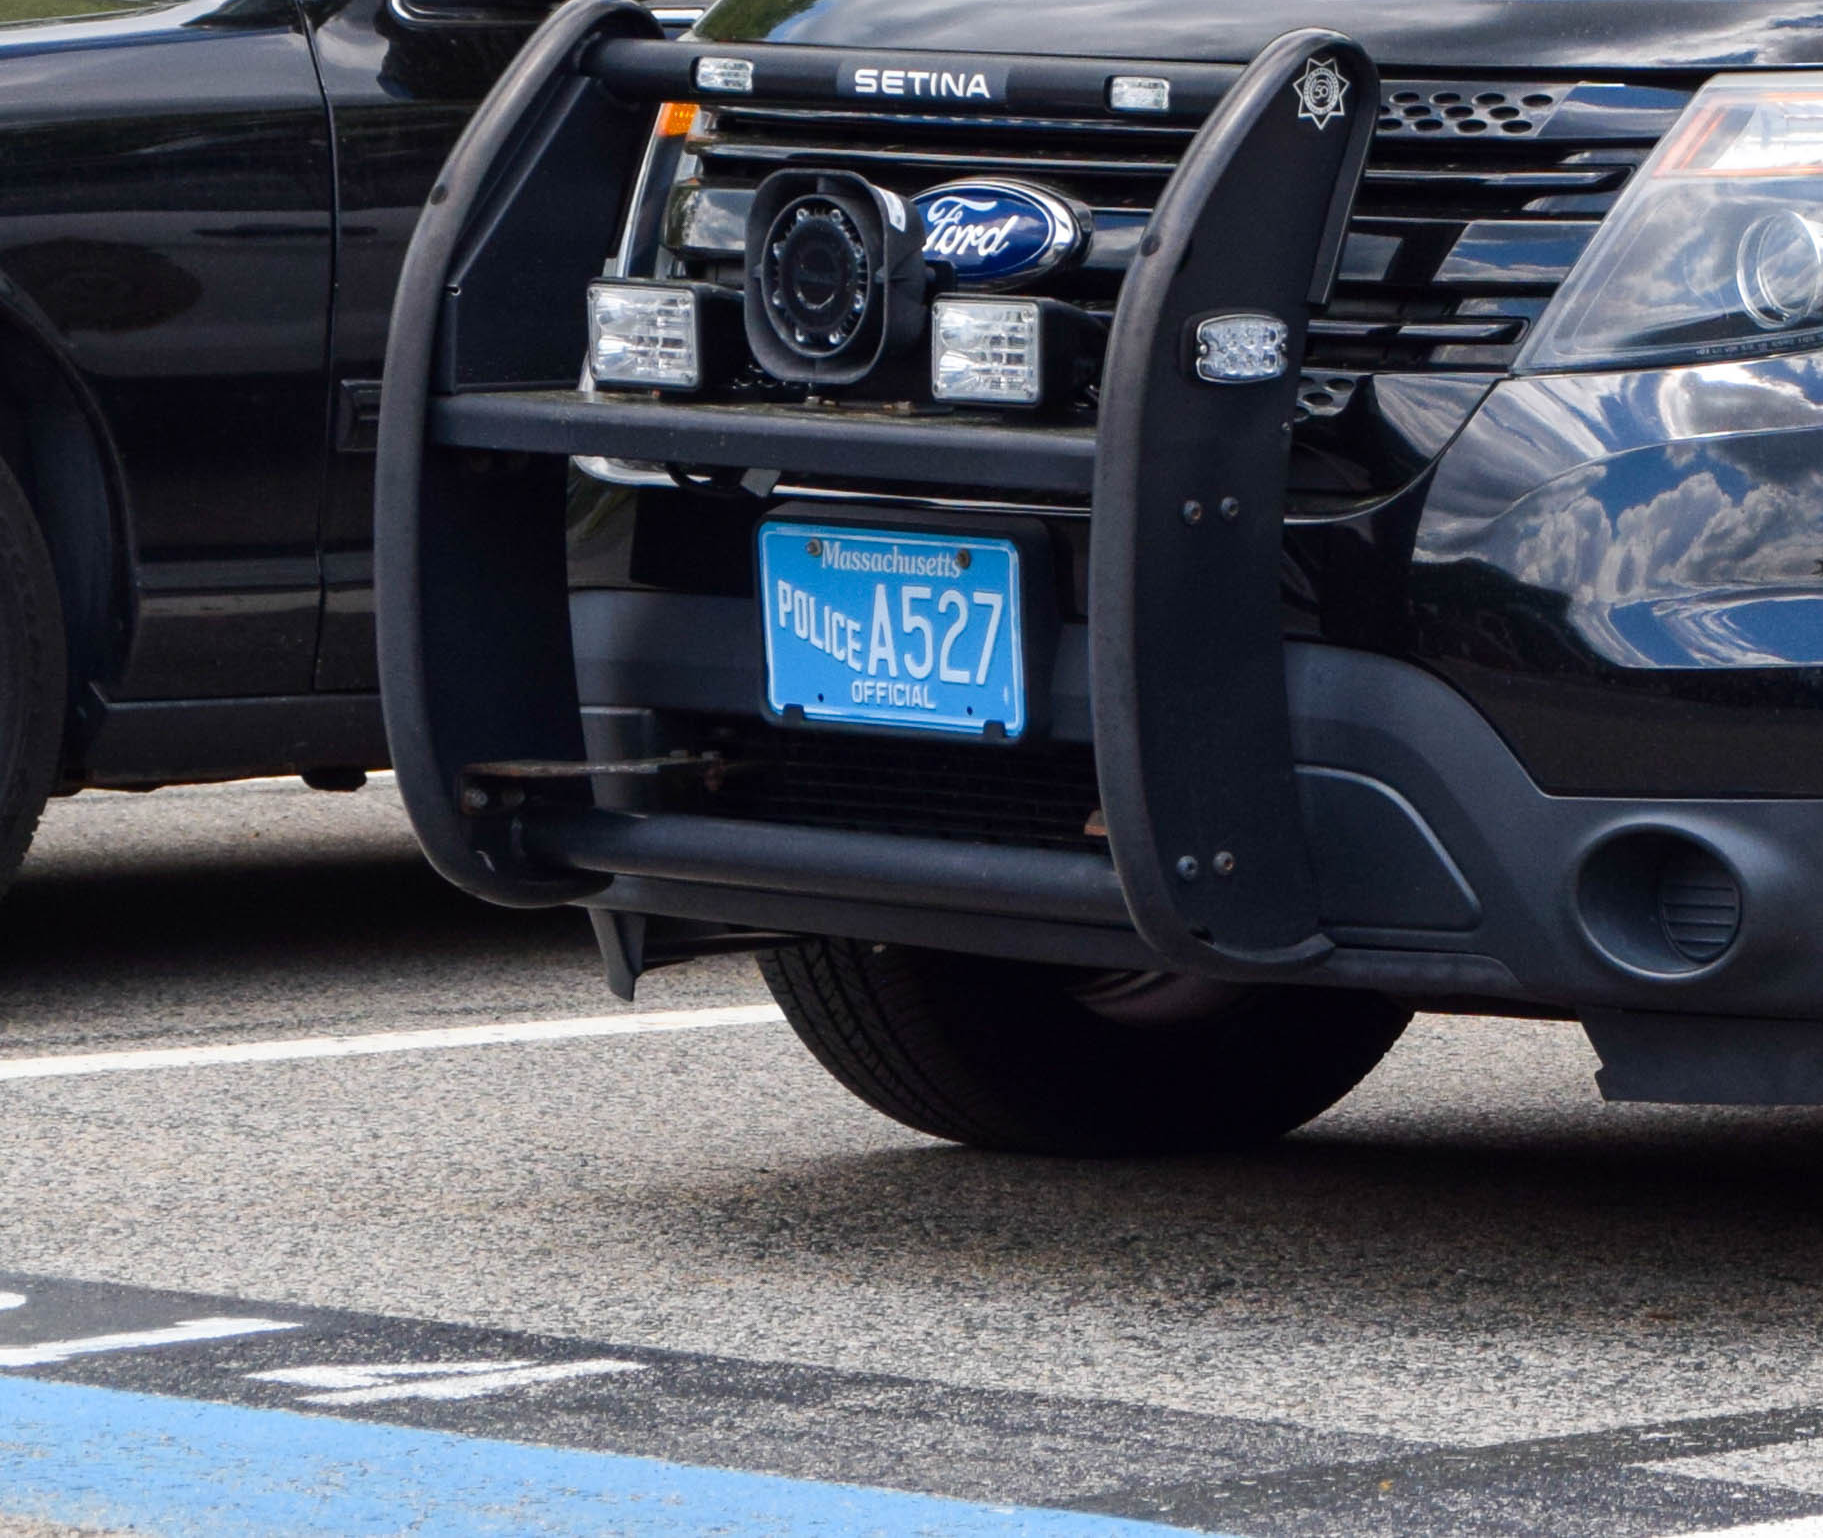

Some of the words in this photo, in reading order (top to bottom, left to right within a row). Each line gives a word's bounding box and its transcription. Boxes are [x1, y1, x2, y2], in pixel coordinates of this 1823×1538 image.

[854, 68, 991, 99] SETINA
[922, 196, 1019, 256] Ford
[821, 540, 962, 578] Massachusetts
[777, 579, 863, 673] POLICE
[867, 584, 1003, 686] A527
[851, 680, 936, 710] OFFICIAL
